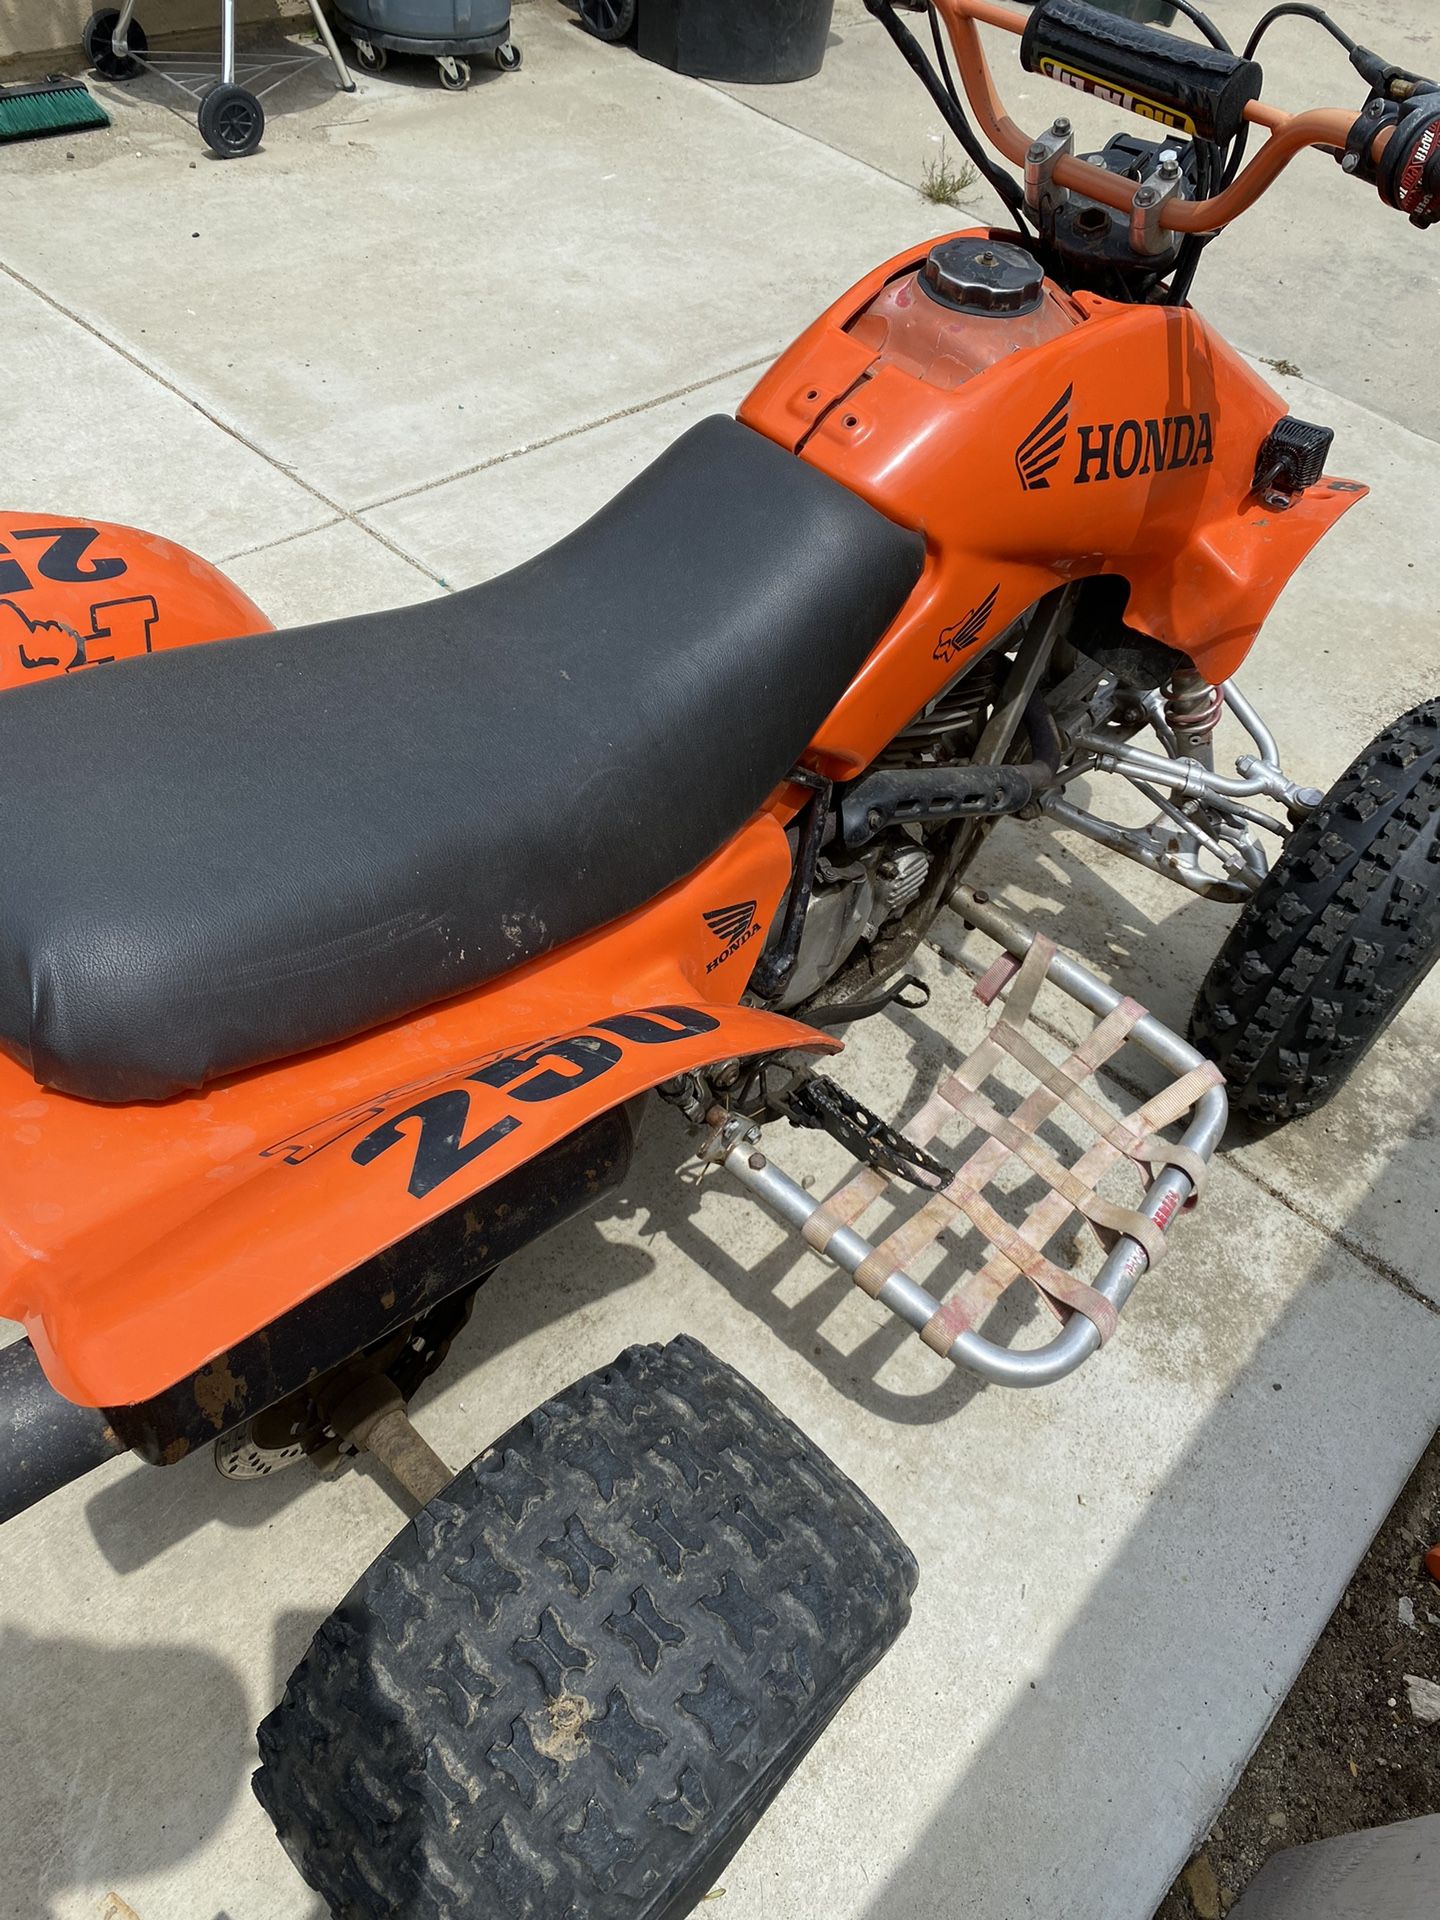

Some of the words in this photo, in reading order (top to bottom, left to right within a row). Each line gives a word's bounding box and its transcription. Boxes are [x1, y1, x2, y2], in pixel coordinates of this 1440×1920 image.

[1414, 129, 1435, 161] TAPER
[1073, 412, 1214, 484] HONDA
[705, 922, 762, 975] HONDA
[350, 1004, 721, 1199] 250
